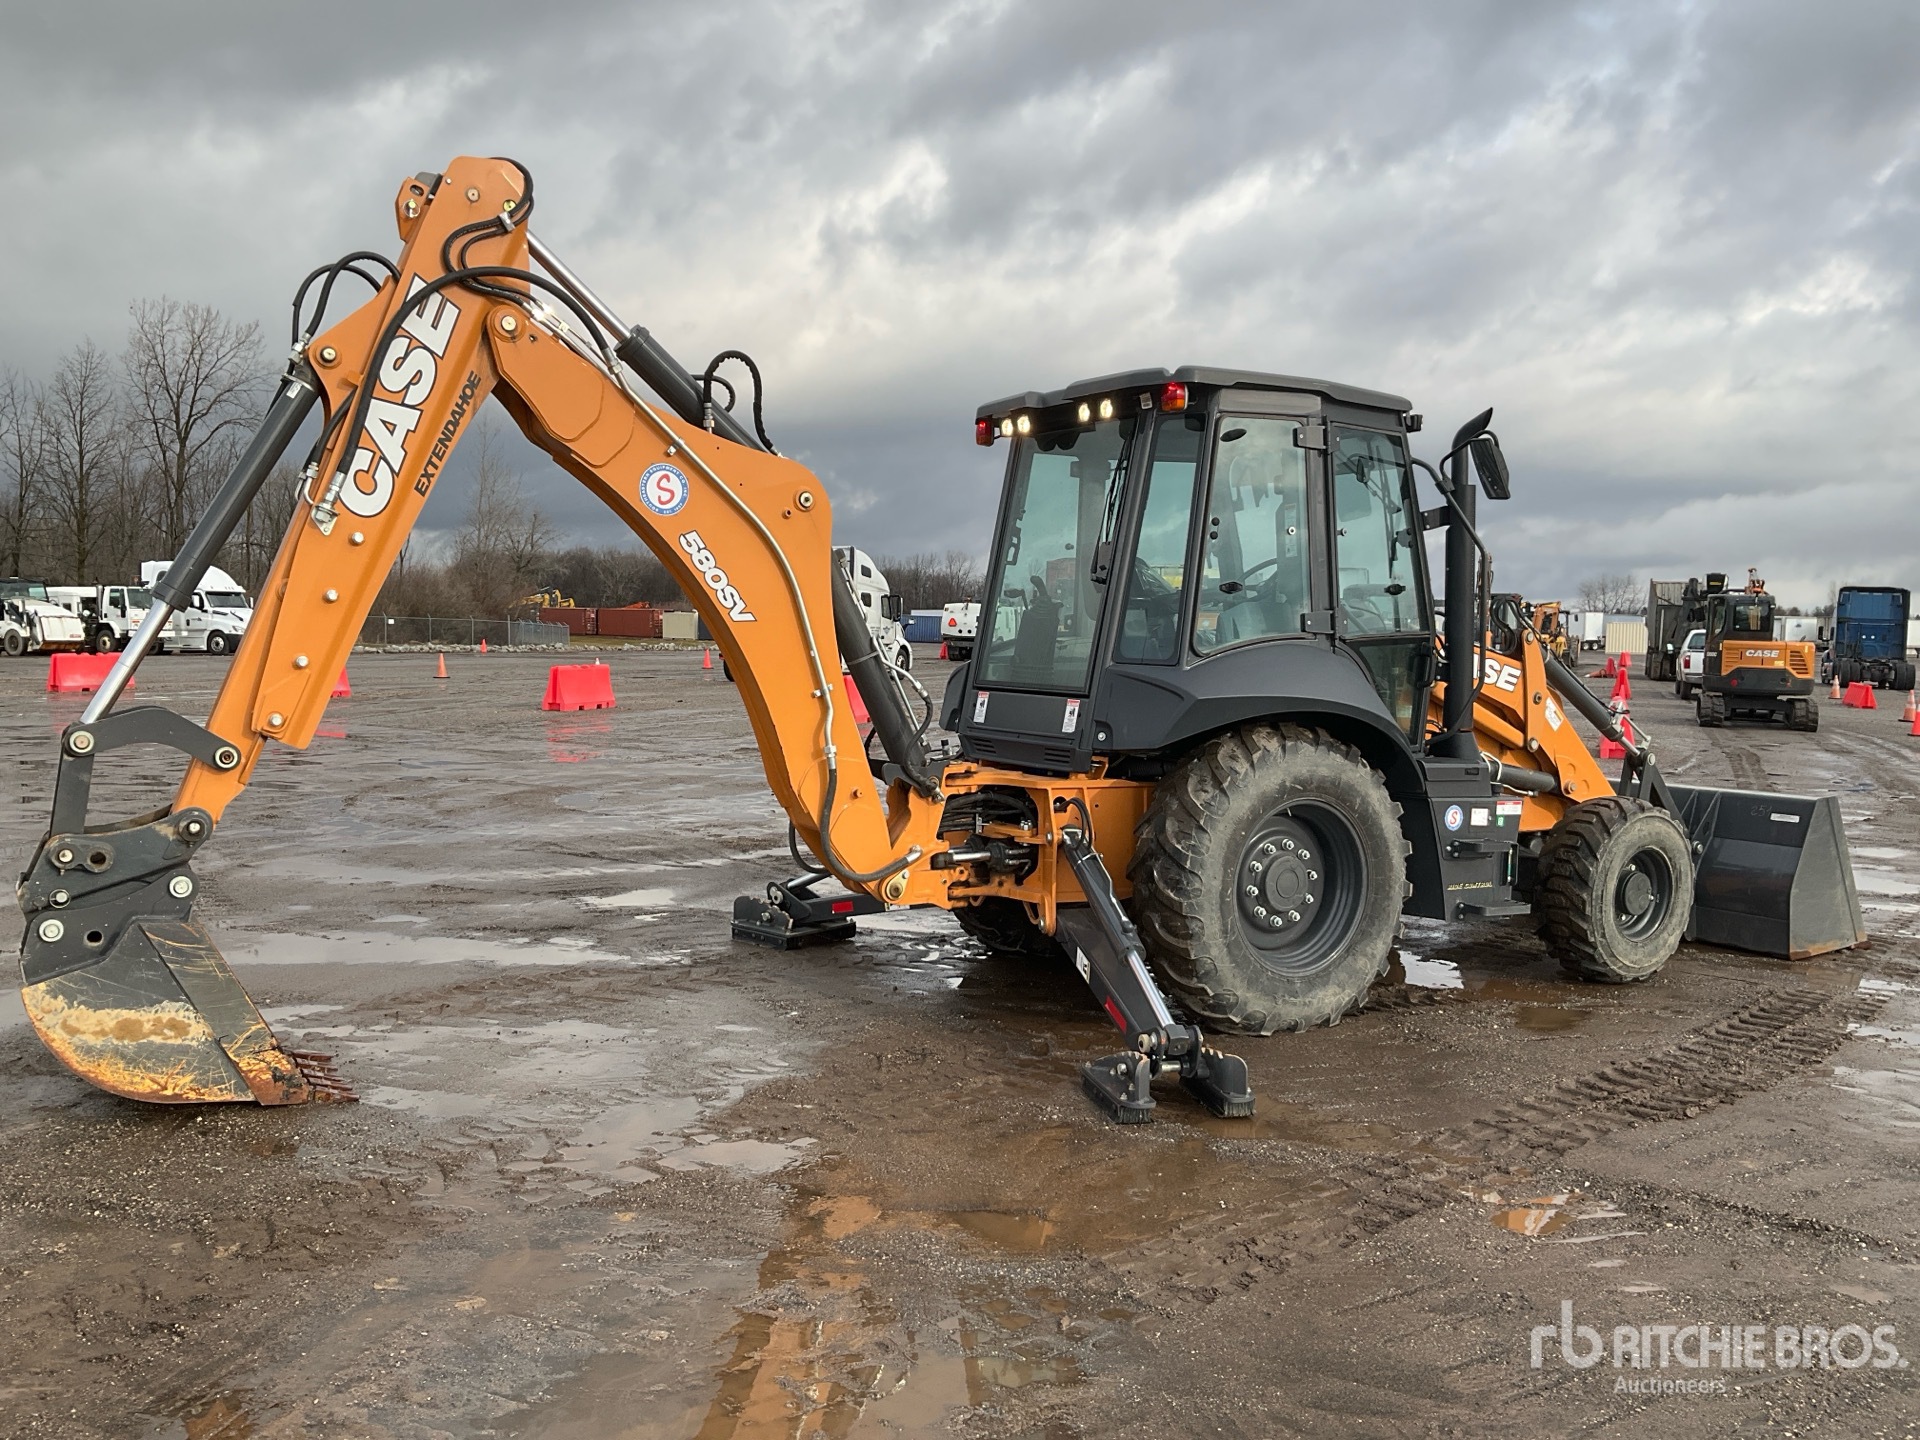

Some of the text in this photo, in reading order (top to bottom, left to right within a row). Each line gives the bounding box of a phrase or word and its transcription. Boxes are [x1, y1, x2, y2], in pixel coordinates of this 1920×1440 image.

[338, 273, 462, 518] CASE
[413, 370, 481, 498] EXTENDAHOE
[656, 473, 675, 505] S
[678, 529, 758, 622] 580SV
[1473, 653, 1522, 693] SE
[1745, 649, 1780, 658] CASE
